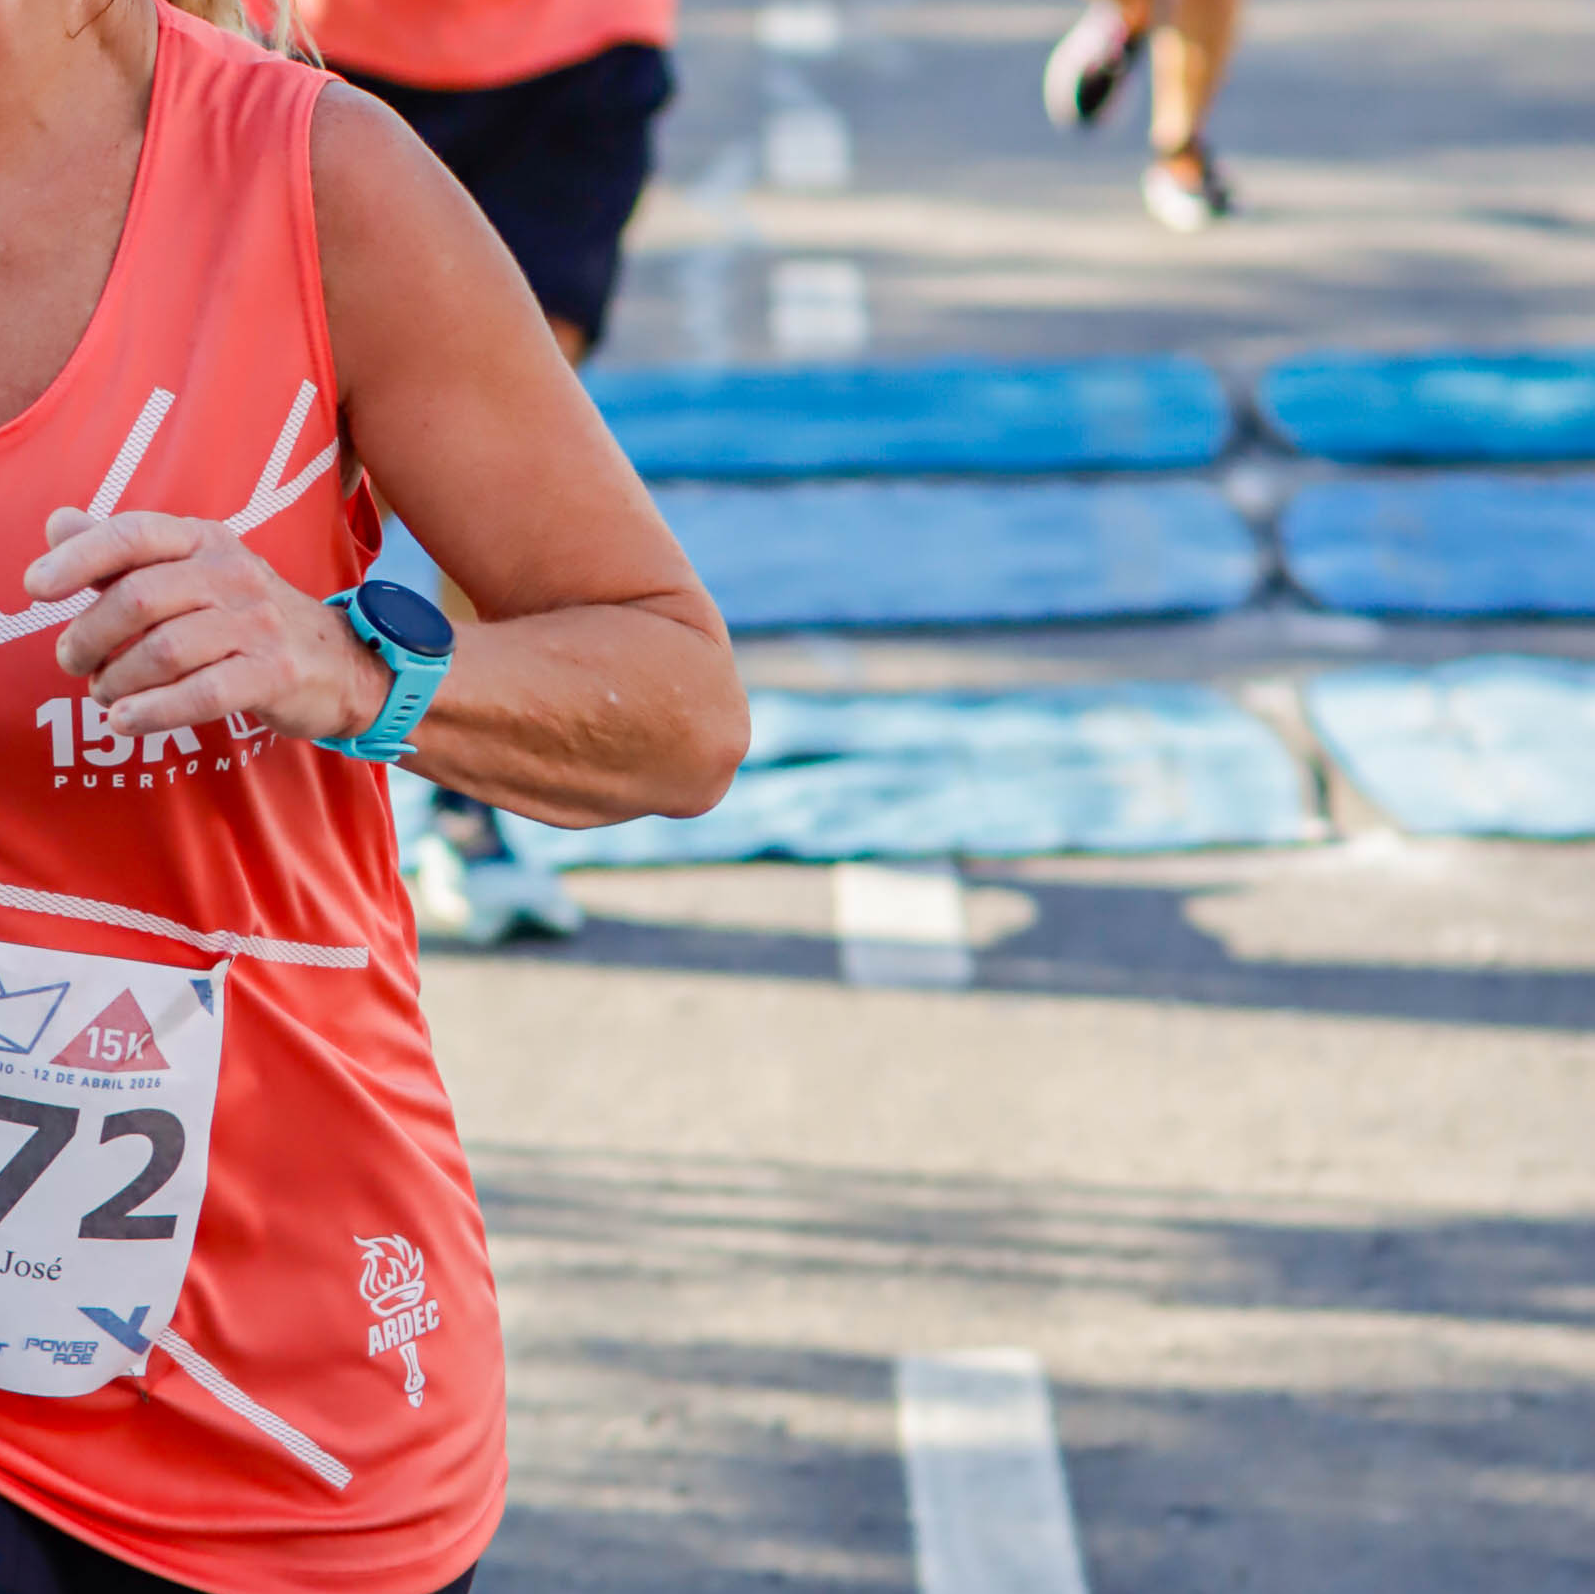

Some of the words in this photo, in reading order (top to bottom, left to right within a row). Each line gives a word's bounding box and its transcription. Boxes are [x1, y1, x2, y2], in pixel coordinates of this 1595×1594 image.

[54, 759, 199, 789] PUERTO
[214, 732, 279, 772] NORT
[85, 1026, 151, 1063] 15K
[33, 1068, 51, 1082] 12
[55, 1072, 75, 1085] DE
[80, 1076, 125, 1090] ABRIL
[129, 1076, 162, 1089] 2026
[23, 1336, 100, 1354] POWER
[367, 1298, 441, 1358] ARDEC
